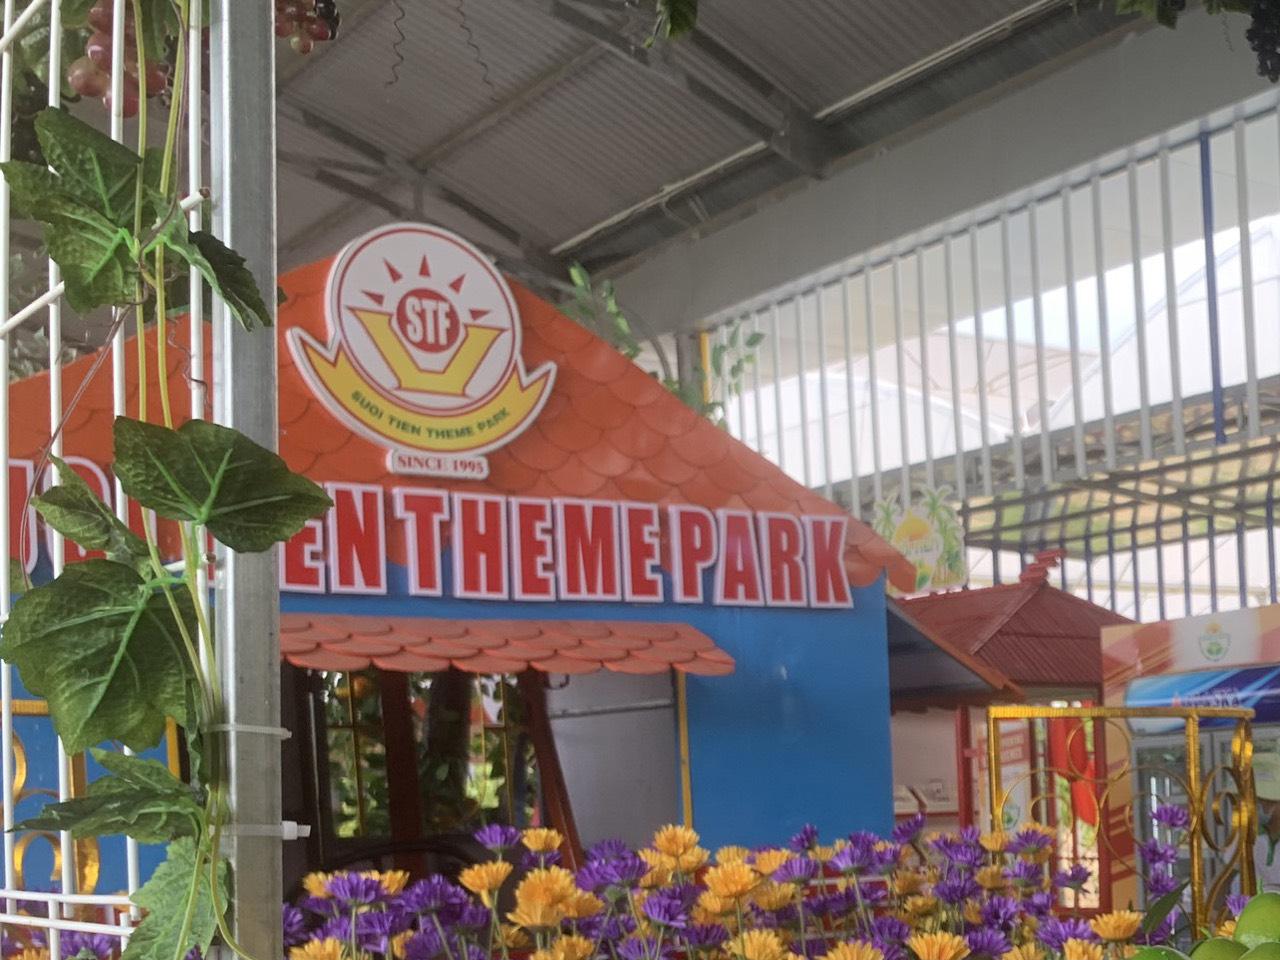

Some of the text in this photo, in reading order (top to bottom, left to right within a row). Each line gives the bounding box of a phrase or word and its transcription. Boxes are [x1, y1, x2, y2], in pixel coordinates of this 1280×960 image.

[405, 296, 450, 346] STF
[427, 427, 475, 440] THEME
[477, 407, 511, 432] PARK
[398, 455, 485, 474] SINCE 1995
[392, 487, 664, 602] THEME
[668, 504, 854, 609] PARK
